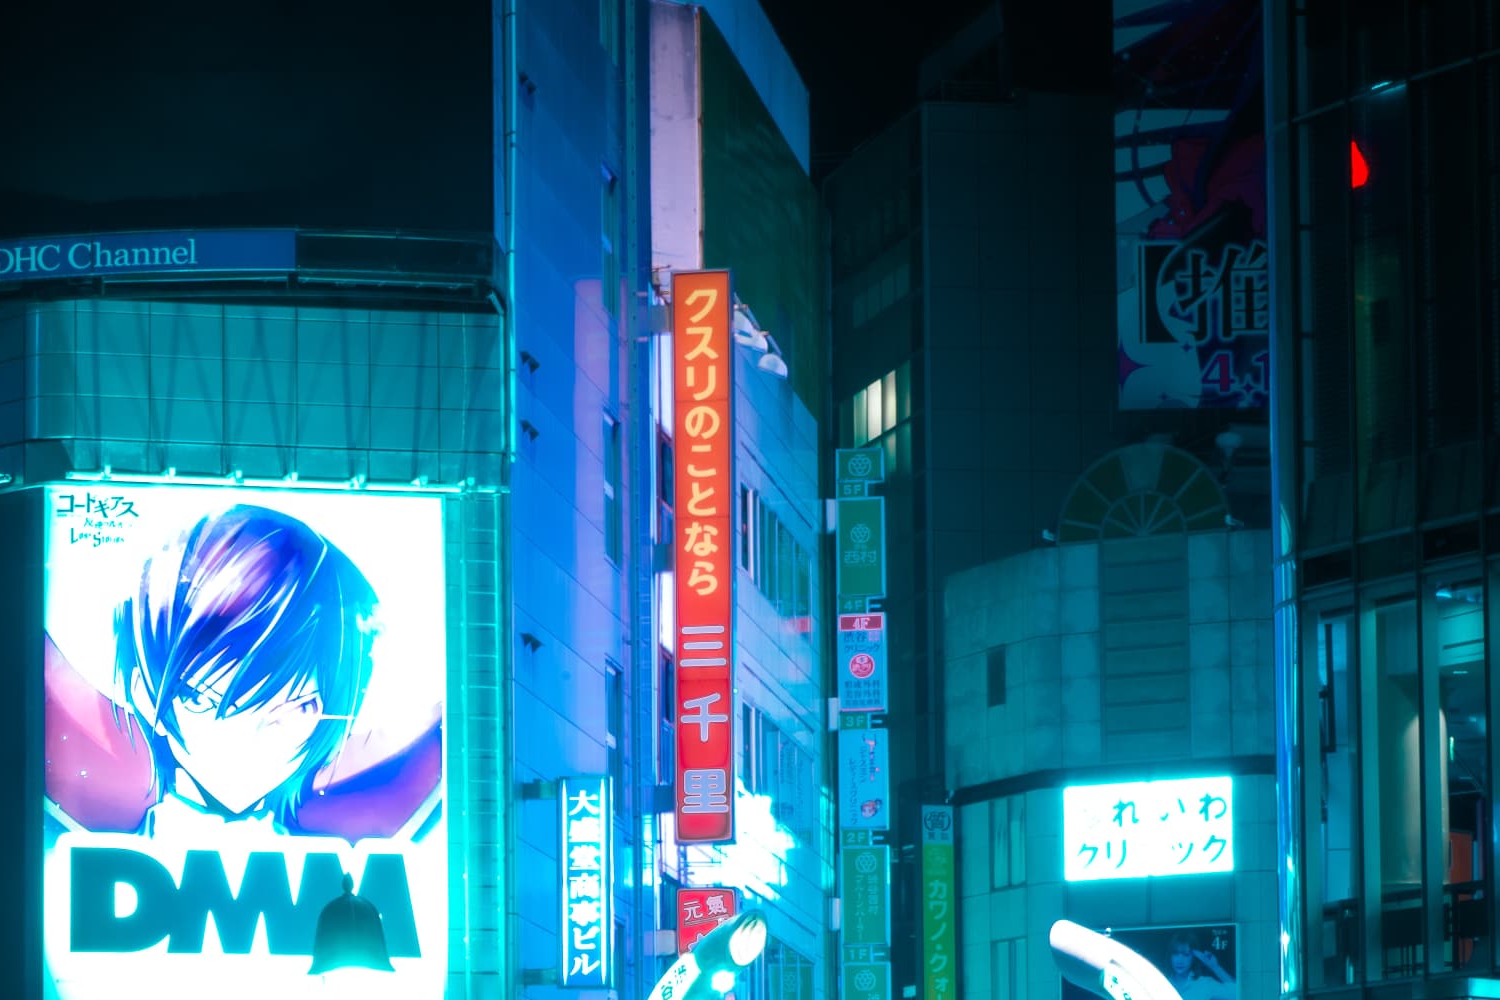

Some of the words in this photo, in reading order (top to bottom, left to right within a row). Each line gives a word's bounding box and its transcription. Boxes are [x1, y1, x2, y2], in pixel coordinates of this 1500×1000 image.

[67, 238, 198, 270] Channel
[683, 288, 721, 597] クスリのことなら
[55, 492, 140, 519] コードギアス
[851, 616, 871, 630] 4F
[680, 625, 729, 814] 三千里
[1077, 834, 1228, 869] クリック
[69, 846, 422, 959] DMM
